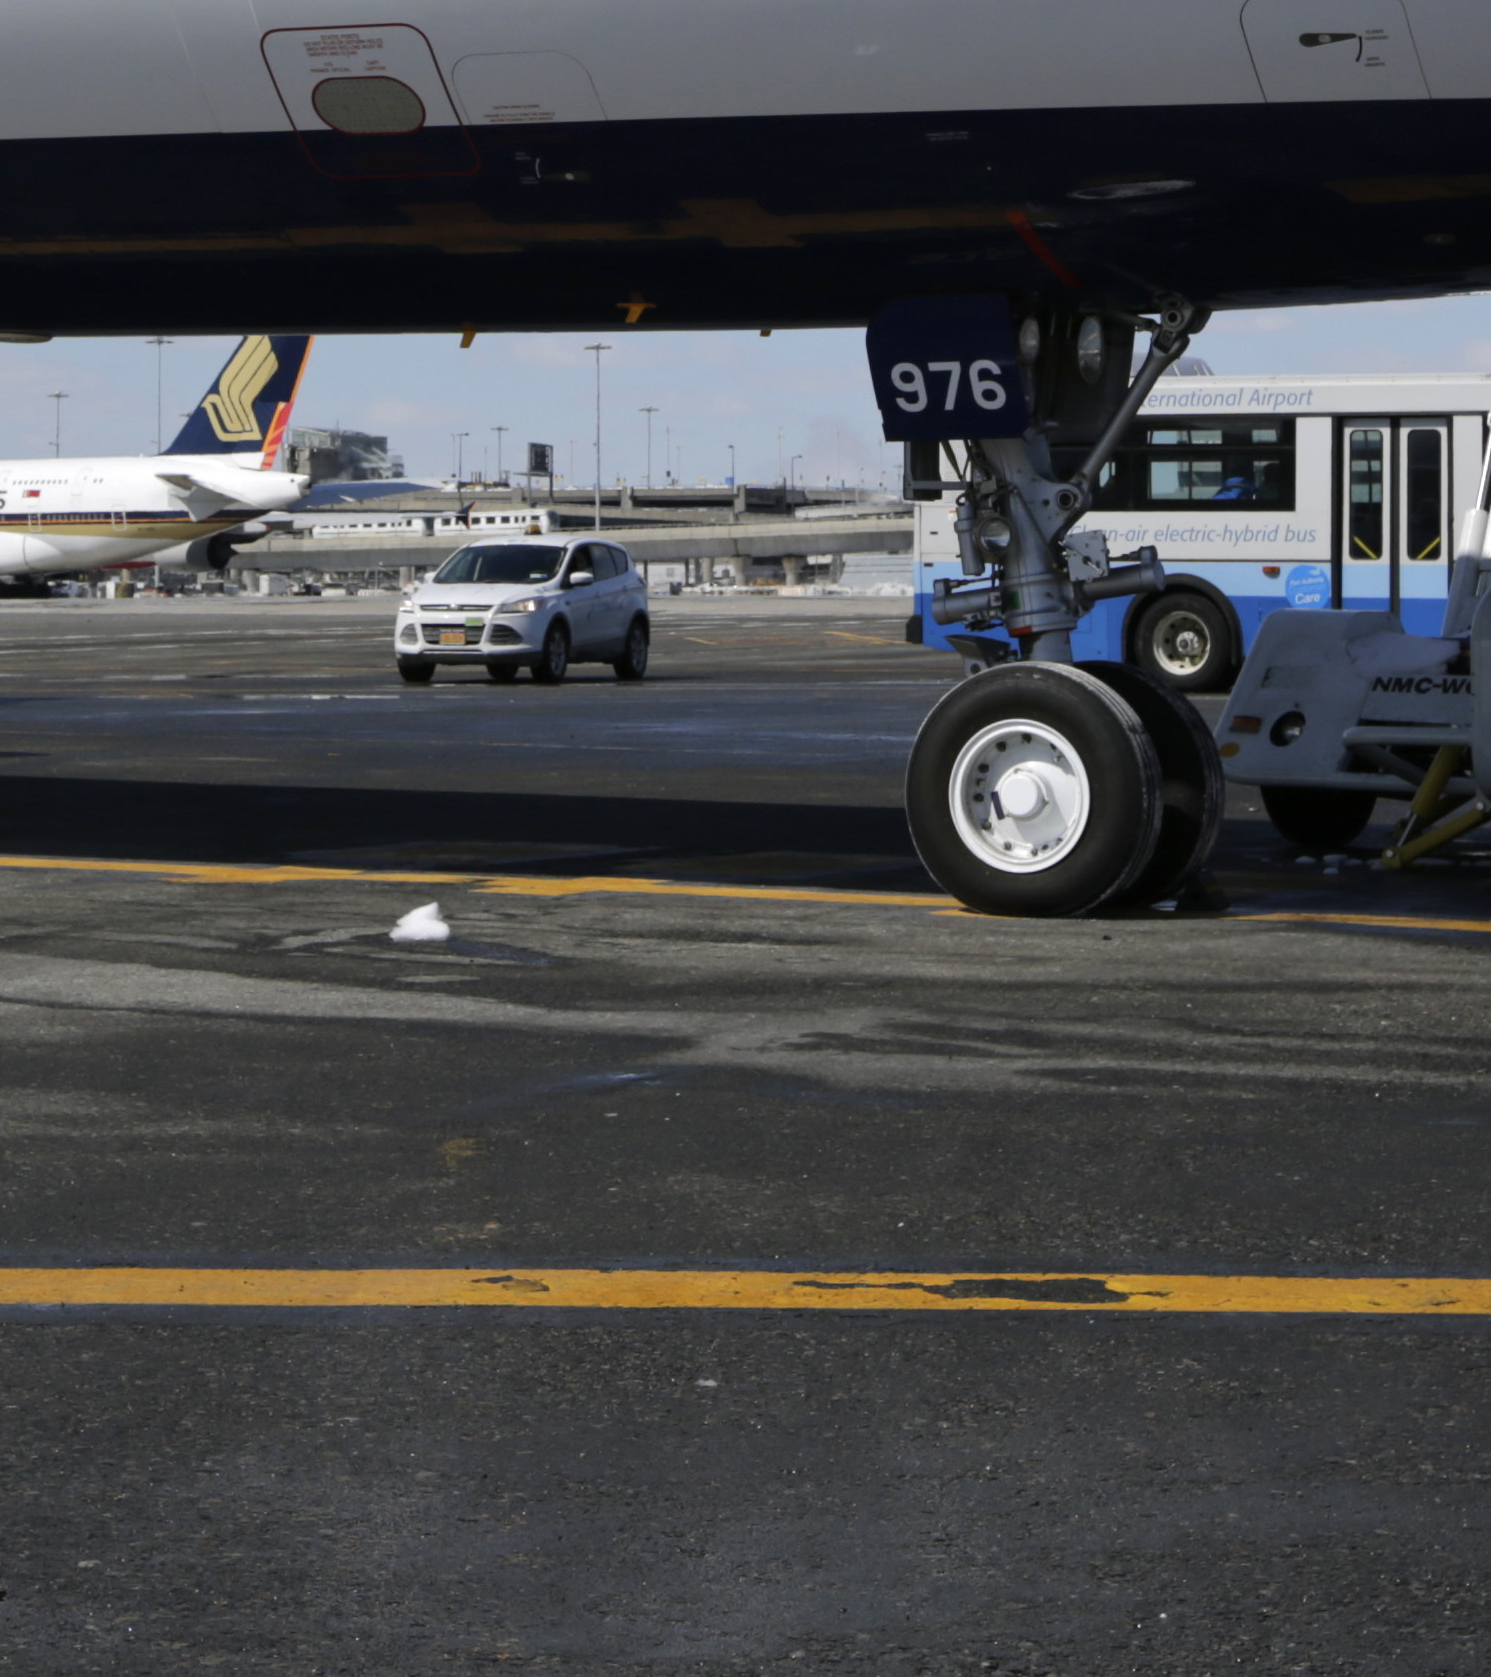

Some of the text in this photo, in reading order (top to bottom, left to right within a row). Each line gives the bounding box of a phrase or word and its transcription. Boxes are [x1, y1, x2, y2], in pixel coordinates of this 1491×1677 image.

[891, 360, 1007, 412] 976
[1248, 389, 1313, 411] Airport
[1154, 523, 1277, 547] electric-hybrid
[1284, 524, 1317, 542] bus
[1295, 593, 1320, 604] Care
